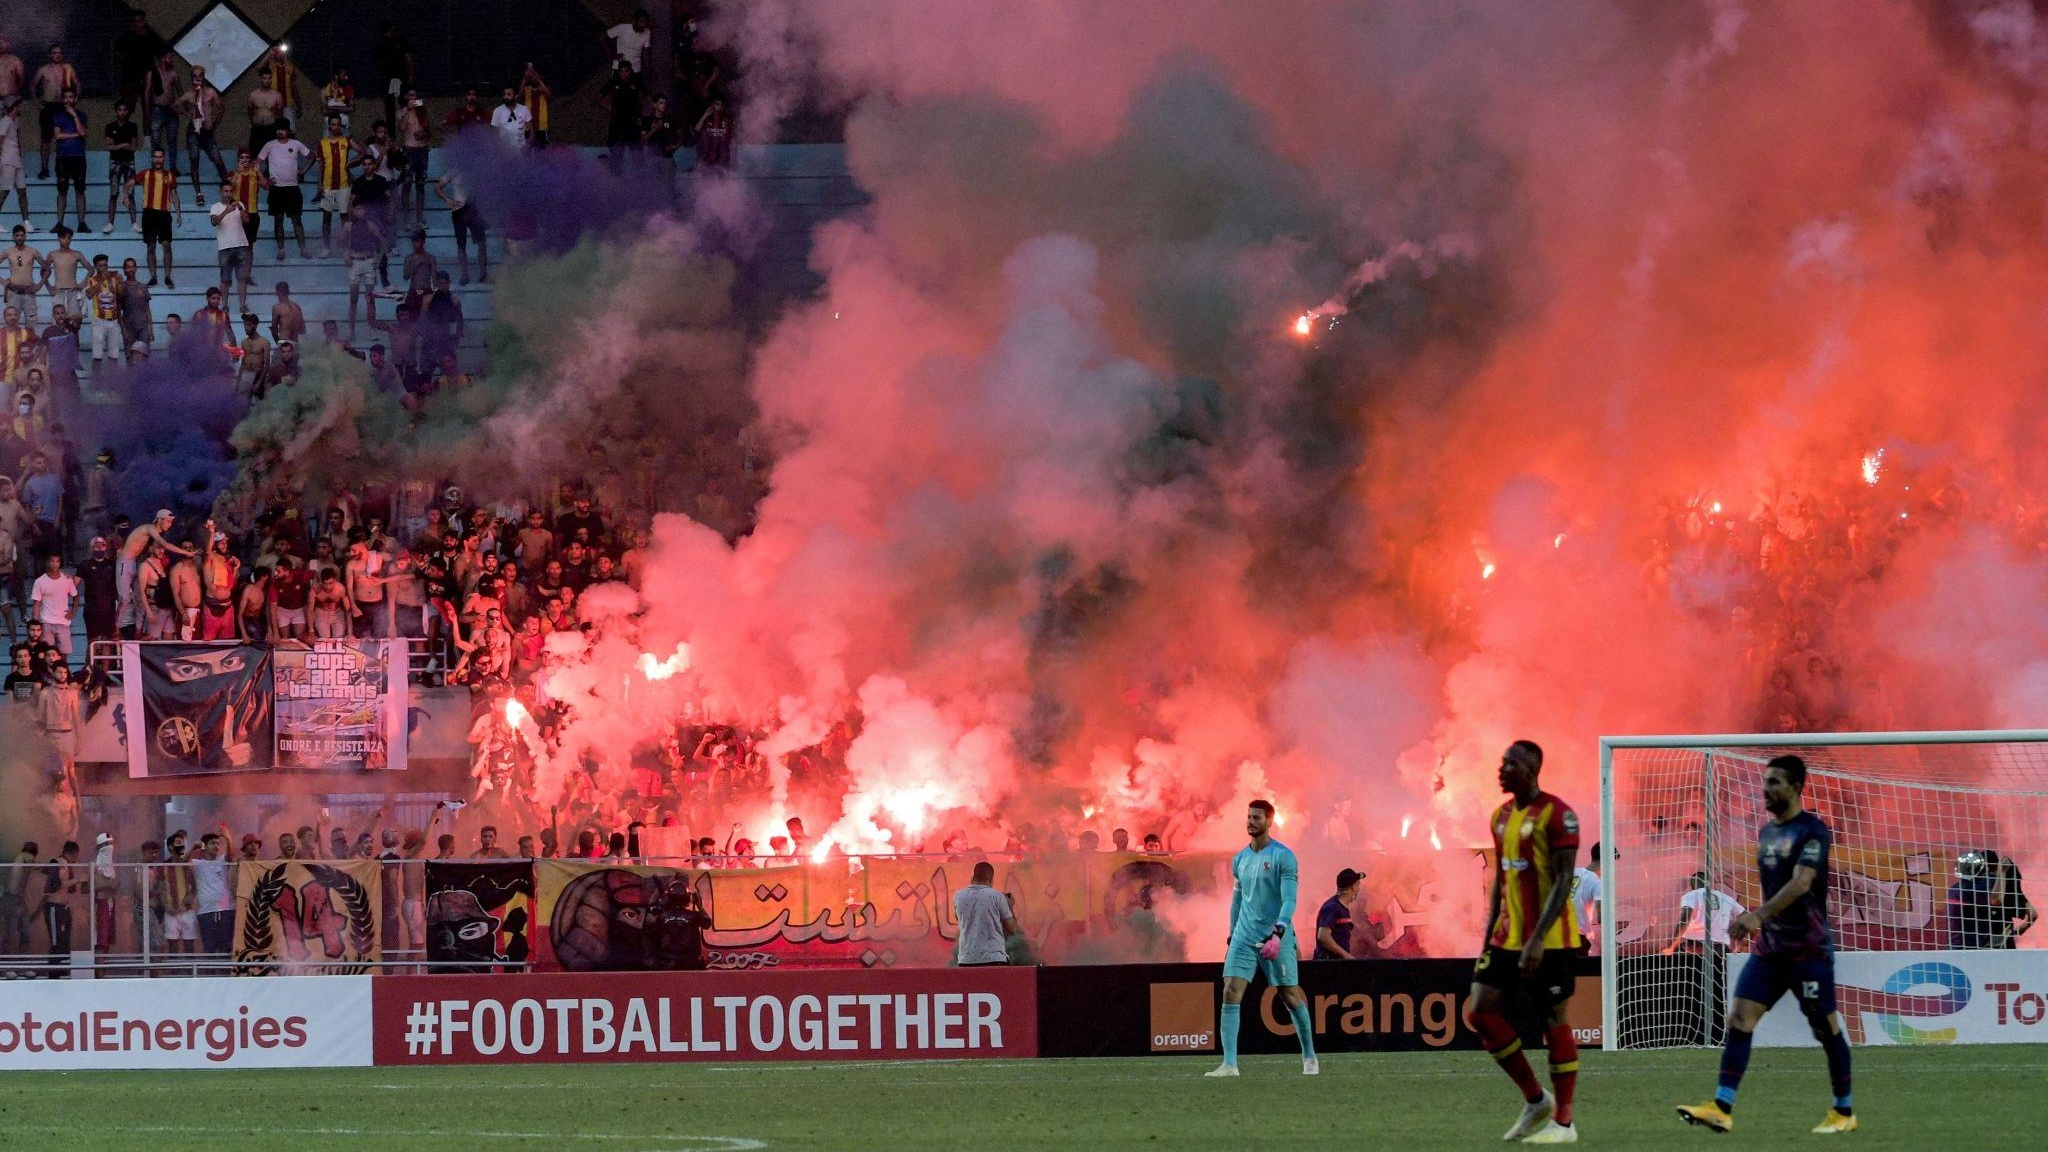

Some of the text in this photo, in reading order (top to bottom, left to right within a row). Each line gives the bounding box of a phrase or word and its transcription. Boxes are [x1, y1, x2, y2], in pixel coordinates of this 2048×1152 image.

[280, 739, 385, 753] ONORE E RESISTENZA
[269, 879, 348, 961] 14
[1802, 982, 1819, 998] 12
[1985, 983, 2048, 1025] To
[0, 1005, 308, 1062] otalEnergies
[405, 993, 1003, 1055] #FOOTBALLTOGETHER
